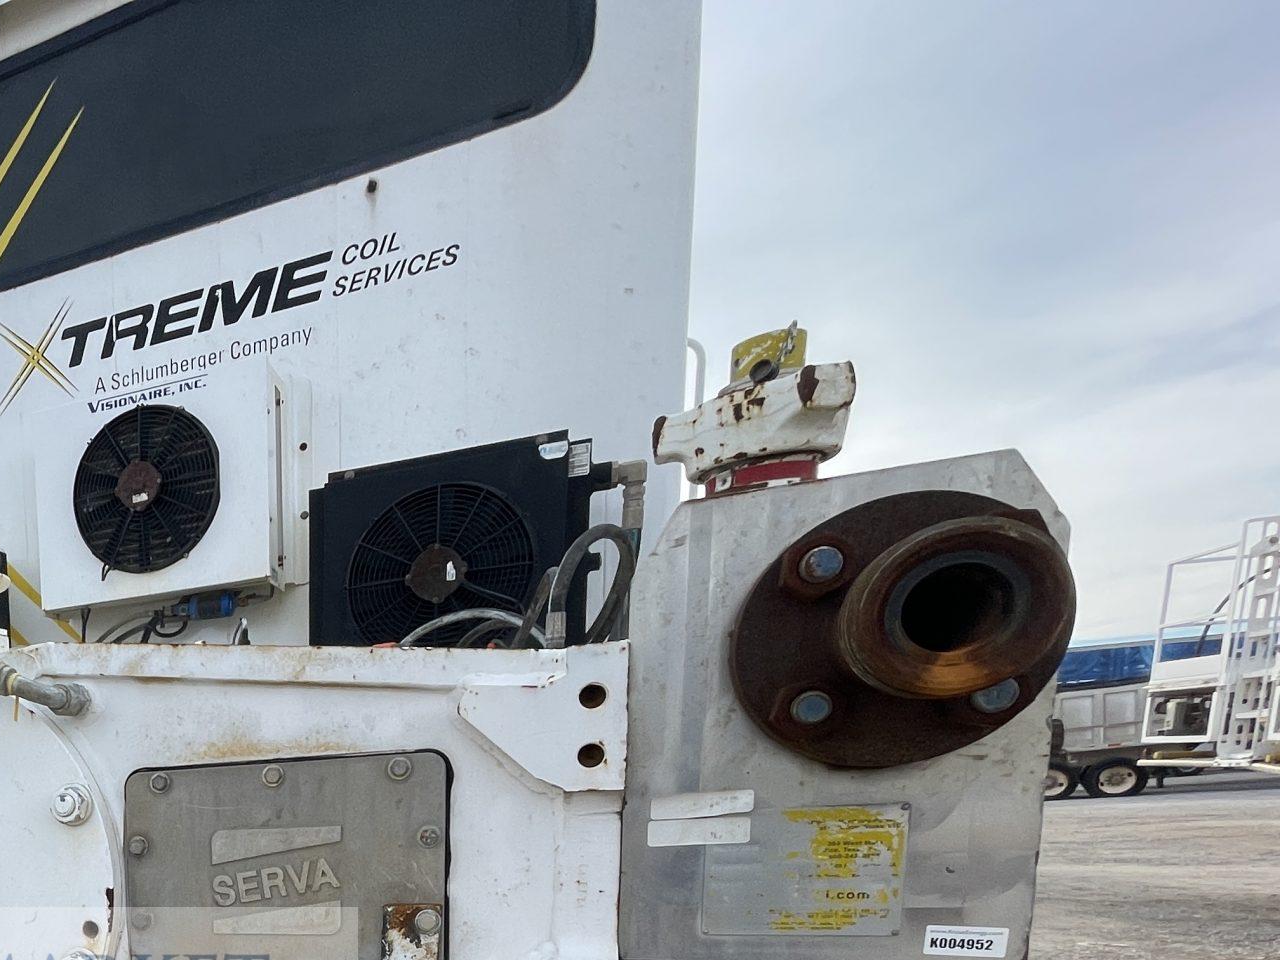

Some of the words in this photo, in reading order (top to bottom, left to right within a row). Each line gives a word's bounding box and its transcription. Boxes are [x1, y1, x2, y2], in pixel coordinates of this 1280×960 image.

[331, 244, 461, 297] SERVICES
[341, 231, 401, 265] COIL
[94, 376, 106, 395] A
[110, 347, 226, 391] Schlumberger
[230, 325, 313, 361] Company
[212, 857, 341, 907] SERVA
[929, 937, 994, 951] K004952
